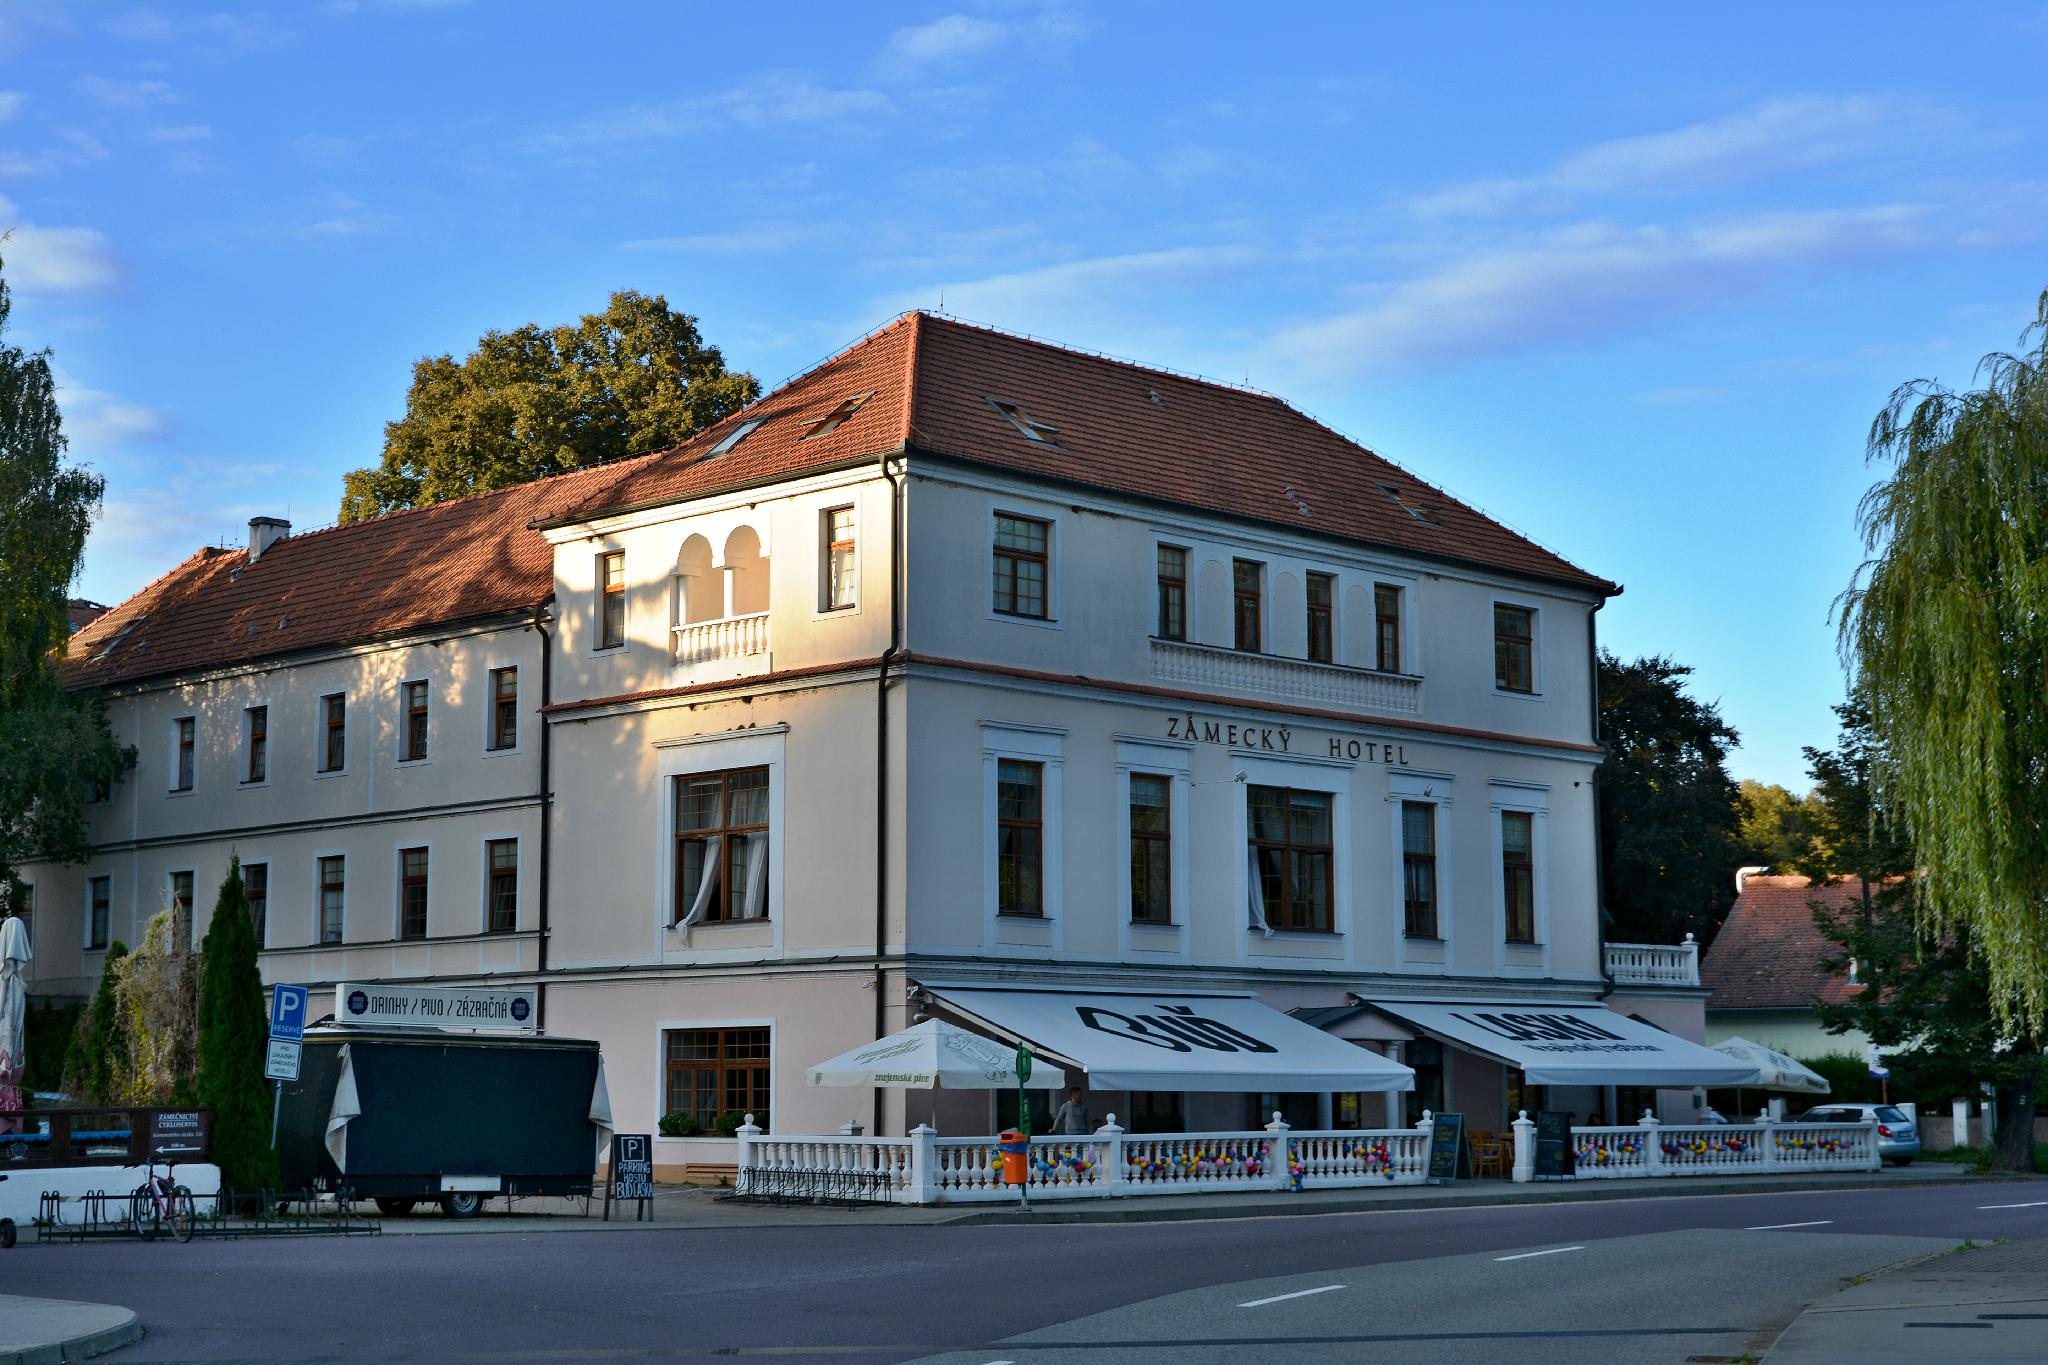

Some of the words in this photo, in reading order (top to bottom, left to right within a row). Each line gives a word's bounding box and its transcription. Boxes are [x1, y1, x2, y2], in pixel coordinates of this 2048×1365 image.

[1167, 711, 1291, 751] ZÁMECKÝ
[1329, 738, 1408, 765] HOTEL
[279, 991, 300, 1021] P
[371, 996, 408, 1014] DRINKY
[421, 998, 443, 1016] PIVO
[456, 995, 507, 1018] ZÁZRAČNÁ
[628, 1140, 638, 1158] P
[618, 1161, 650, 1174] PARKING
